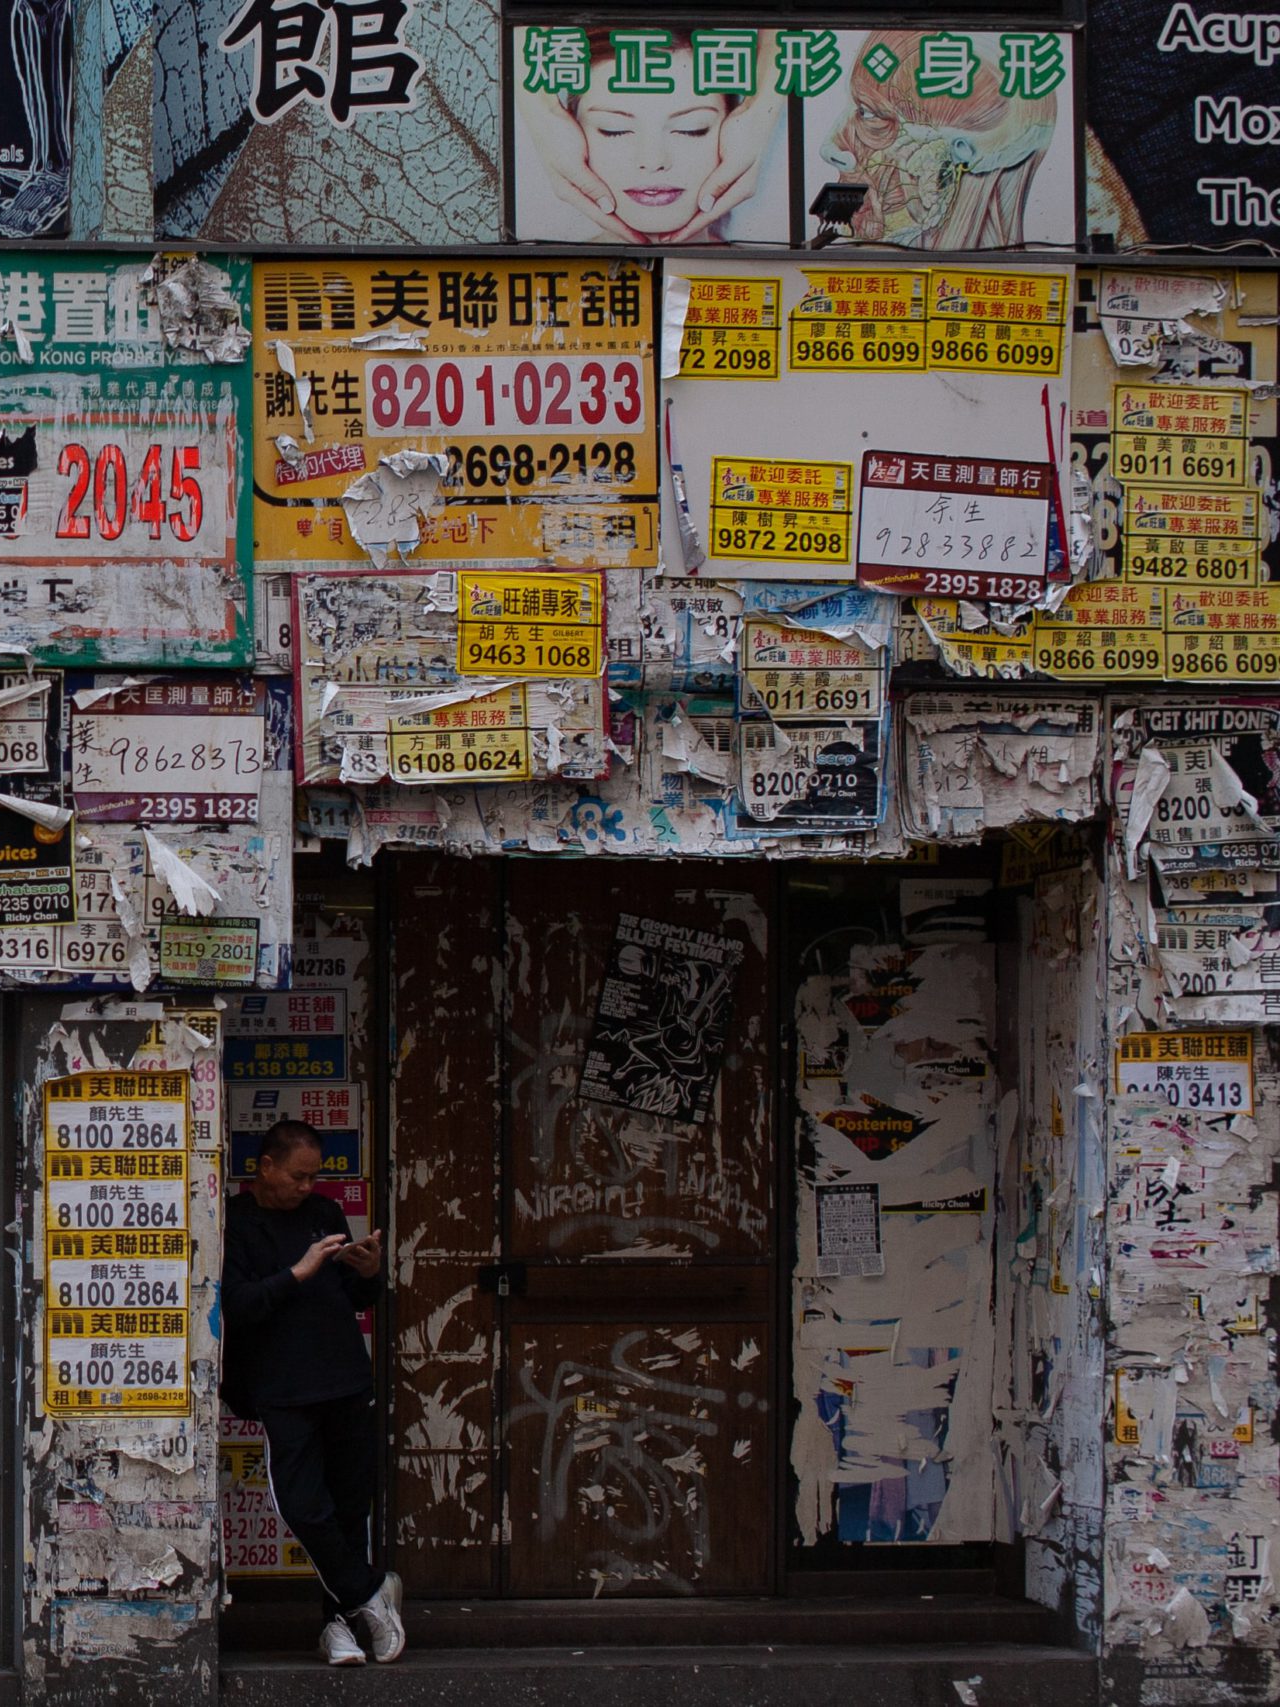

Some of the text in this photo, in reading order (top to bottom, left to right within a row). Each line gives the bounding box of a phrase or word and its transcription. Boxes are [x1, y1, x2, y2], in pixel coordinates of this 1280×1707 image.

[223, 0, 427, 127] 館
[826, 275, 900, 295] 歡迎委託
[963, 277, 1037, 299] 歡迎委託
[369, 268, 641, 329] 美聯旺舖
[835, 299, 908, 319] 專業服務
[970, 301, 1044, 321] 專業服務
[39, 350, 174, 367] KONG PROPERTY
[713, 349, 772, 371] 2098
[796, 341, 920, 364] 9866 6099
[930, 340, 1055, 367] 9866 6099
[1156, 414, 1228, 434] 專業服務
[749, 466, 822, 487] 歡迎委託
[910, 460, 1043, 490] 天匡測量師行
[1120, 454, 1236, 479] 9011 6691
[55, 443, 204, 542] 2045
[757, 490, 830, 510] 專業服務
[718, 528, 842, 554] 9872 2098
[874, 527, 1040, 562] 92833882
[1131, 555, 1250, 581] 9482 6801
[924, 572, 981, 596] 2395
[986, 577, 1042, 601] 1828
[503, 587, 580, 618] 旺舖專家
[479, 625, 585, 644] 胡先生 GILBERT
[469, 643, 591, 668] 9463 1068
[1038, 648, 1160, 670] 9866 6099
[1171, 653, 1228, 674] 9866
[815, 689, 872, 711] 6691
[1184, 711, 1219, 732] SHIT
[109, 737, 261, 775] 98628373
[398, 749, 522, 774] 6108 0624
[139, 797, 198, 819] 2395
[203, 798, 259, 820] 1828
[1158, 795, 1211, 822] 8200
[1221, 843, 1258, 858] 6235
[32, 895, 70, 910] 0710
[66, 941, 126, 963] 6976
[163, 941, 255, 961] 3119 2801
[288, 996, 336, 1013] 旺舖
[288, 1015, 336, 1032] 租售
[1158, 1035, 1249, 1058] 美聯旺舖
[1156, 1065, 1211, 1082] 陳先生
[89, 1076, 183, 1097] 美聯旺舖
[1188, 1082, 1243, 1107] 3413
[301, 1089, 350, 1108] 旺舖
[57, 1123, 178, 1149] 8100 2864
[834, 1116, 914, 1136] Postering
[89, 1155, 183, 1176] 美聯旺舖
[57, 1202, 178, 1228] 8100 2864
[90, 1234, 184, 1255] 美聯旺舖
[58, 1281, 179, 1307] 8100 2864
[90, 1312, 184, 1333] 美聯旺舖
[58, 1359, 179, 1385] 8100 2864
